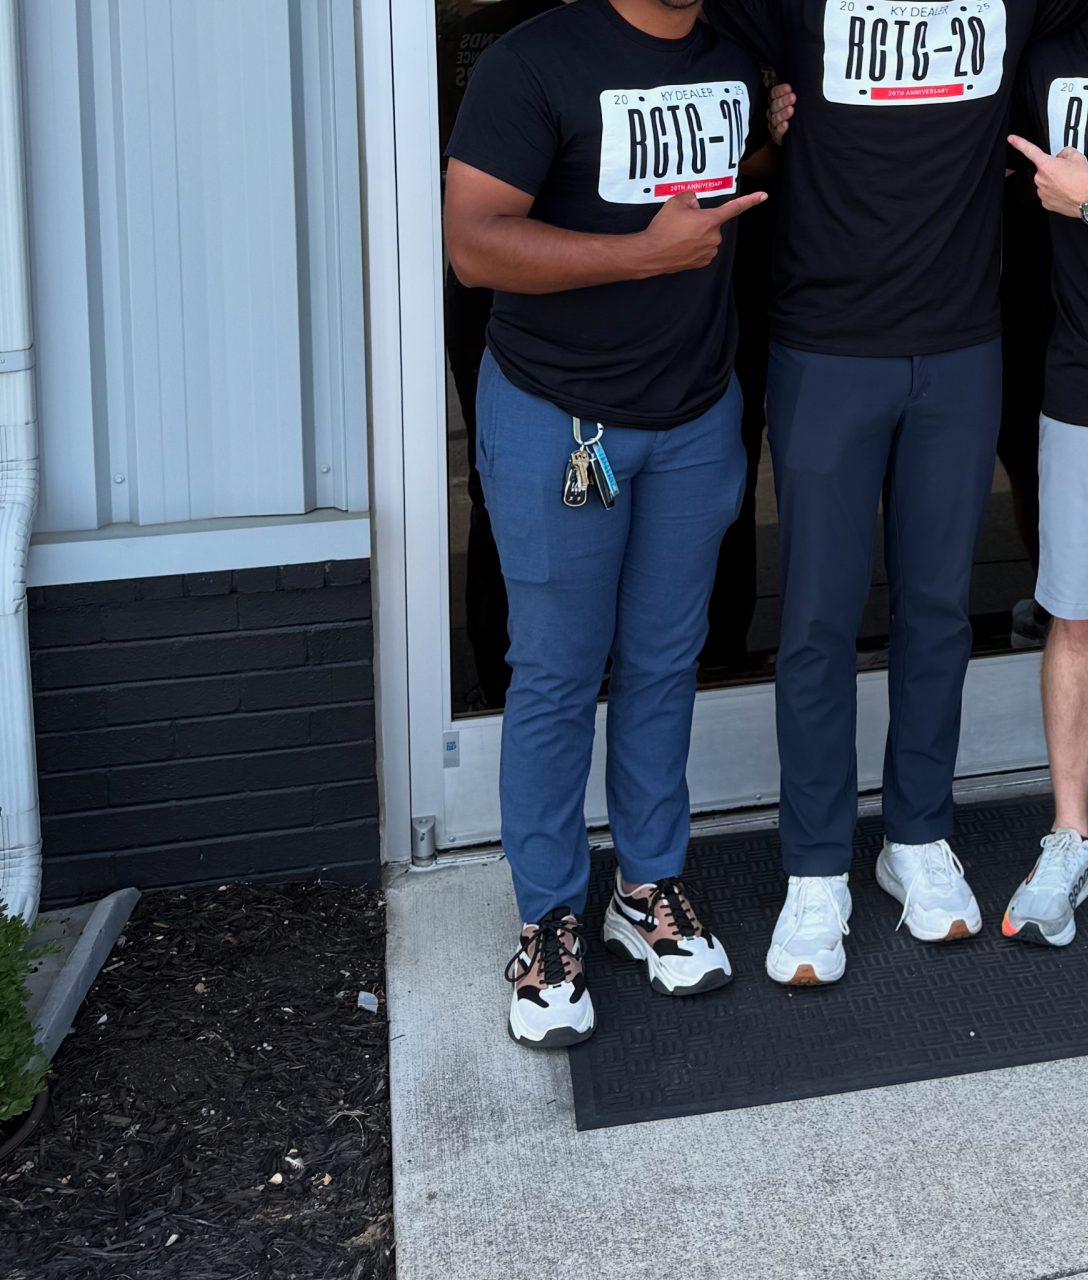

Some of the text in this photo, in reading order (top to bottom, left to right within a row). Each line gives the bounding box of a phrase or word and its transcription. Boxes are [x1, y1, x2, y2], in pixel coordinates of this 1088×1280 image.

[839, 1, 990, 17] 20 KY DEALER 25
[845, 16, 986, 82] RCTC-20
[888, 87, 949, 97] 20TH ANNIVERSARY
[1060, 82, 1074, 93] 20
[613, 94, 628, 105] 20
[660, 90, 675, 102] KY
[675, 87, 714, 100] DEALER
[627, 98, 743, 180] RCTC-20
[670, 180, 723, 192] 20TH ANNIVERSARY
